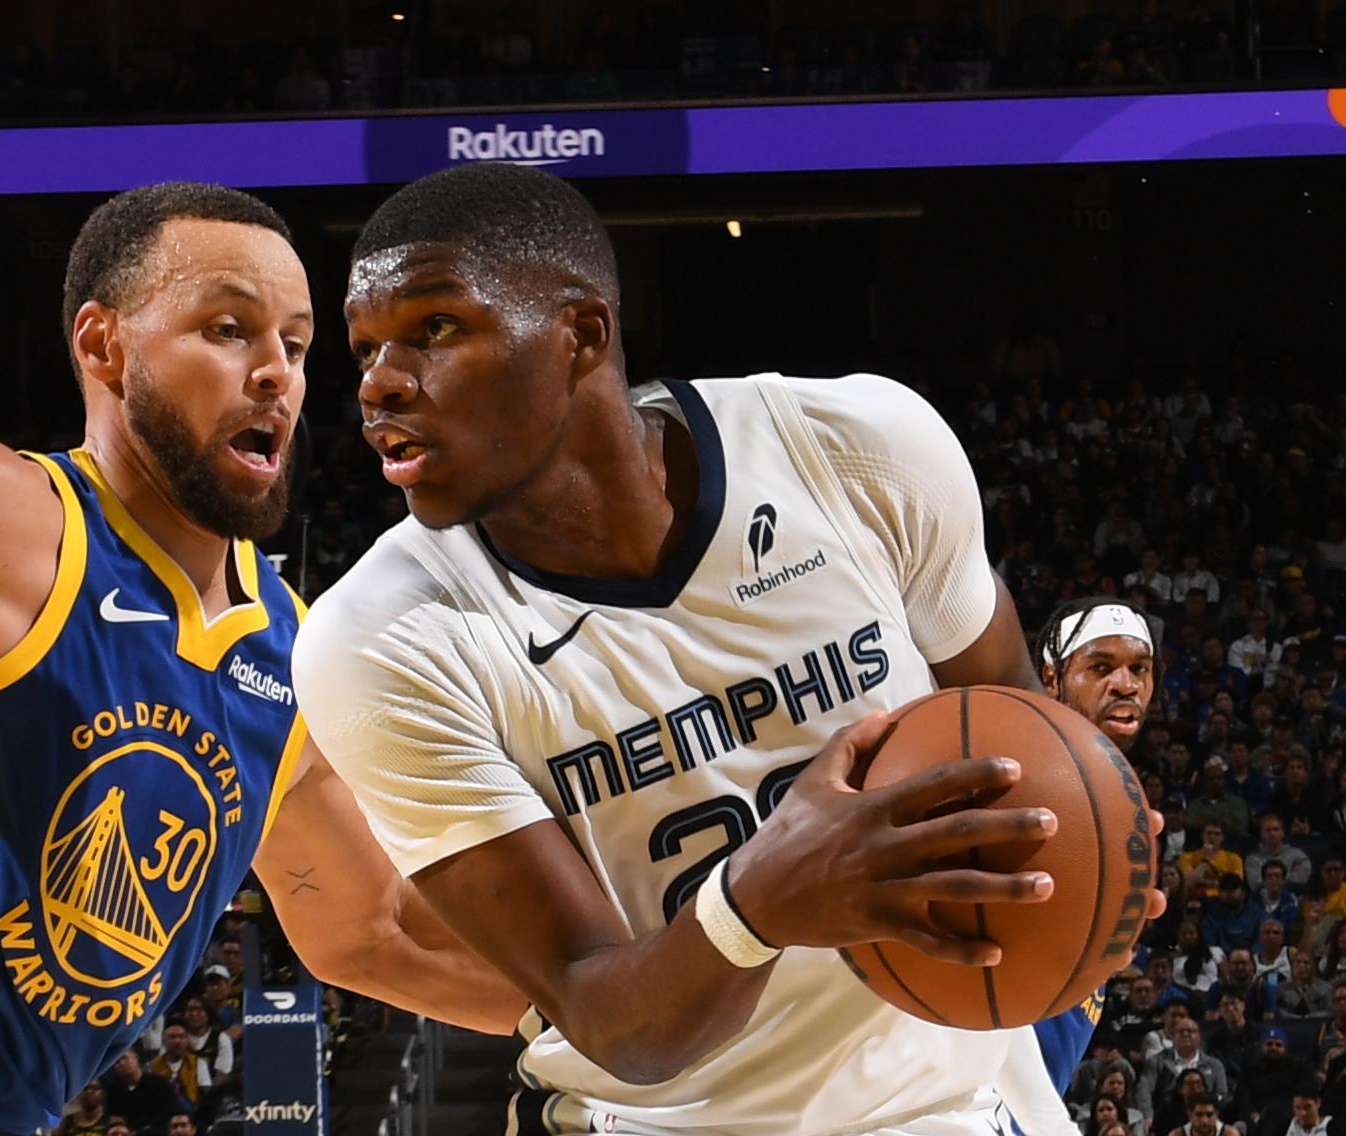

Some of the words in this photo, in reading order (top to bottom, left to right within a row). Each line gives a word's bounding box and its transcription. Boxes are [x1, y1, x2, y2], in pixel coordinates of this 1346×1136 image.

[448, 123, 605, 160] Rakuten
[735, 549, 827, 605] Robinhood
[227, 653, 294, 707] Rakuten
[546, 620, 891, 817] MEMPHIS
[71, 701, 193, 752] GOLDEN
[193, 730, 242, 828] STATE
[139, 809, 206, 894] 30
[244, 1012, 317, 1025] DOORDASH
[245, 1099, 317, 1125] xfinity
